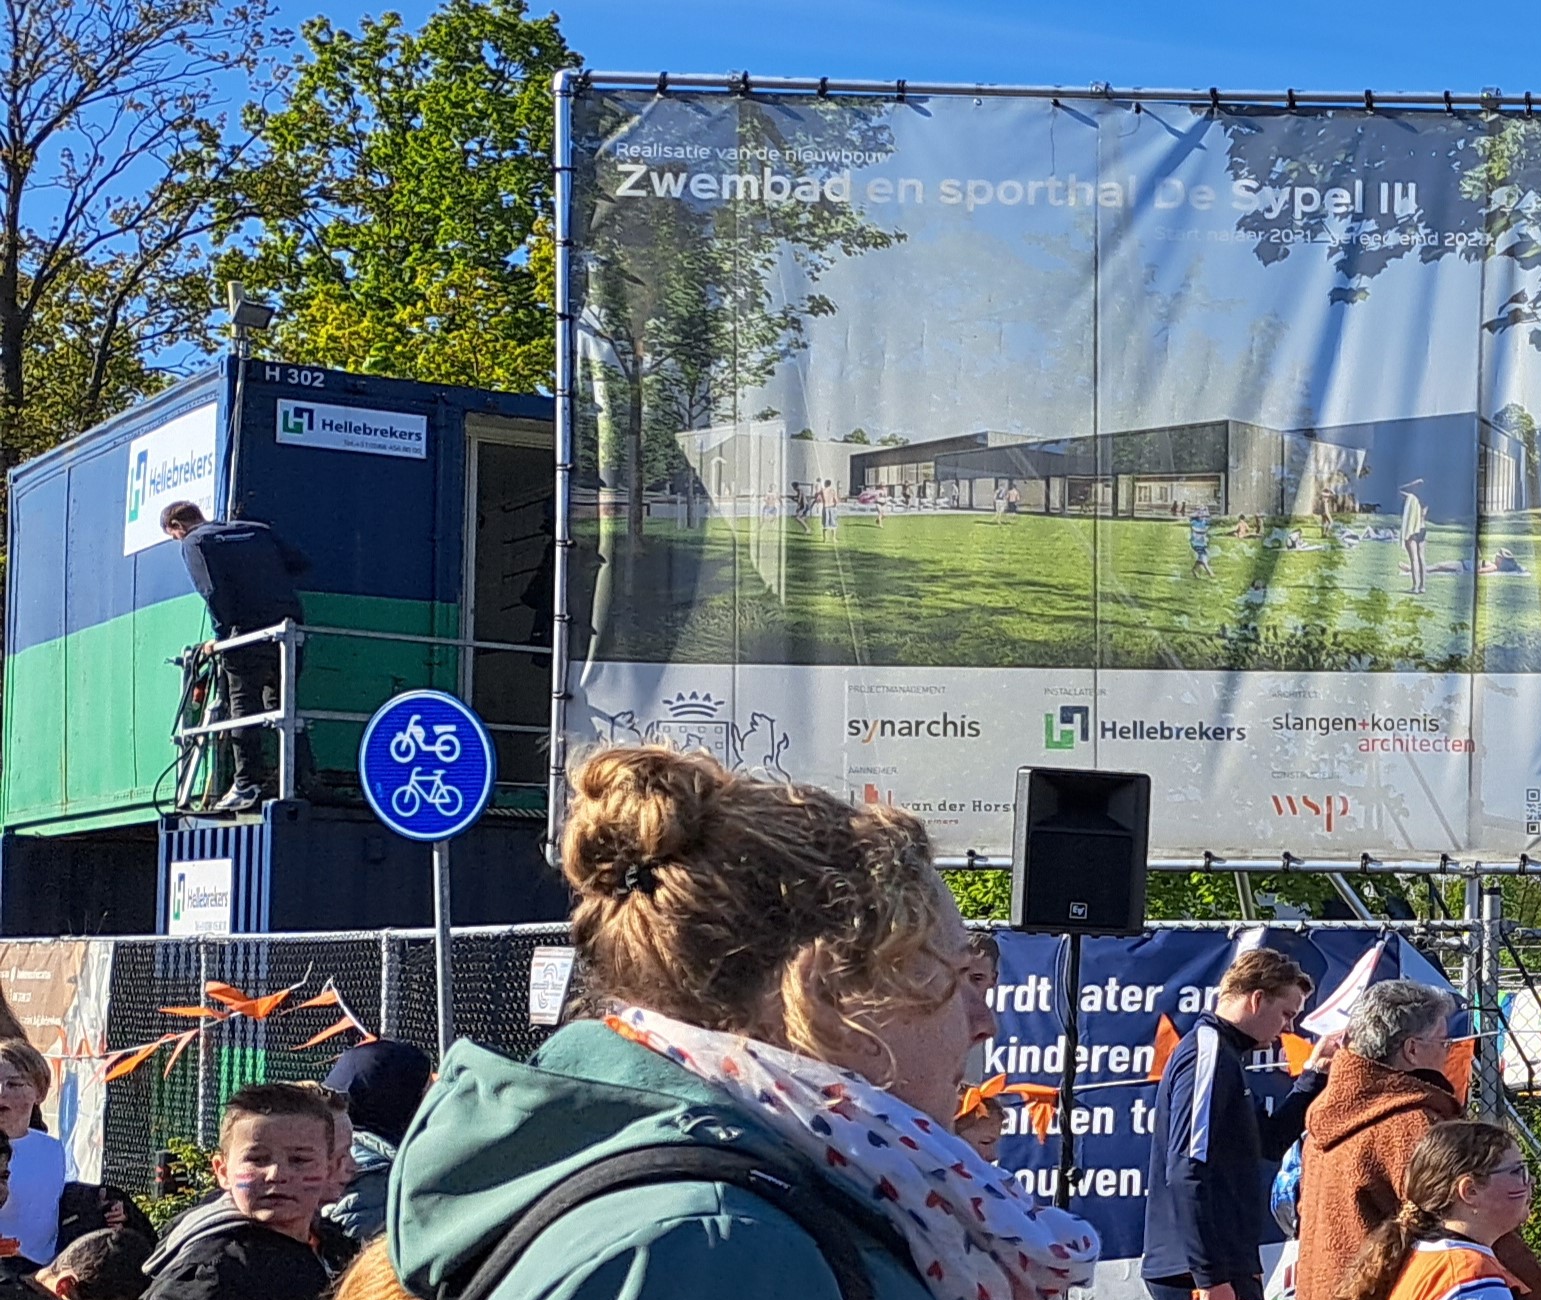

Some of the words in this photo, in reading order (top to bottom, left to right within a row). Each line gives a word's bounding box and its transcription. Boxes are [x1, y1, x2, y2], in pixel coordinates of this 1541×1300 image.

[615, 142, 710, 159] Realisatie
[717, 150, 751, 160] van
[756, 147, 780, 161] de
[785, 149, 892, 164] nieuwbouw
[615, 164, 850, 202] Zwembad
[866, 177, 924, 204] en
[939, 173, 1137, 212] sporthal
[1153, 177, 1215, 210] De
[1231, 178, 1363, 220] Sypel
[1380, 181, 1416, 216] III
[265, 365, 281, 383] H
[287, 368, 325, 389] 302
[321, 418, 423, 442] Hellebrekers
[149, 450, 213, 498] Hellebrekers
[1044, 687, 1106, 697] INSTALLATER
[847, 711, 981, 744] synarchis
[1100, 720, 1247, 742] Hellebrekers
[1272, 713, 1440, 736] slangen+koenis
[1358, 733, 1476, 753] architecten
[901, 802, 933, 812] van
[938, 799, 966, 813] der
[1271, 795, 1349, 832] wsp
[1080, 977, 1164, 1013] ater
[984, 1035, 1155, 1073] kinderen
[996, 1162, 1150, 1198] ouwen.
